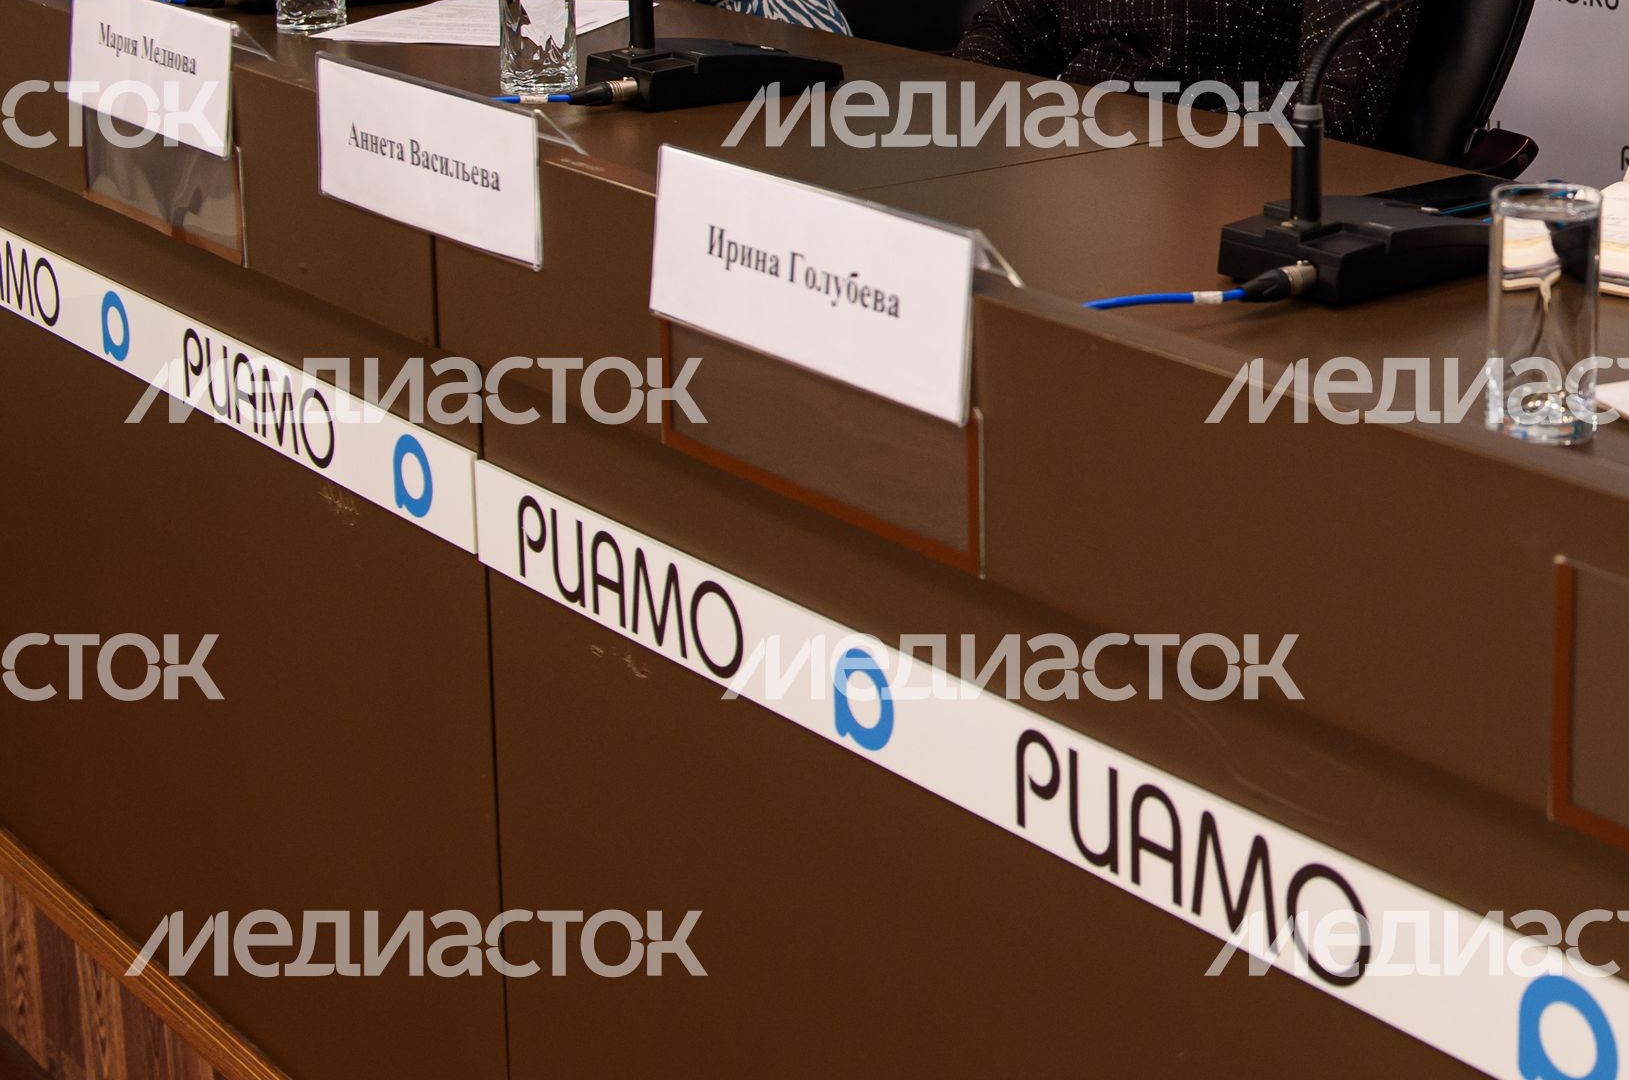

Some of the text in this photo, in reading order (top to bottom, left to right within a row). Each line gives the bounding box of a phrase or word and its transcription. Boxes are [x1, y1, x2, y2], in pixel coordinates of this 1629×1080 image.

[98, 21, 139, 58] Мария
[347, 121, 502, 192] Аннета Васильева
[706, 224, 901, 319] Ирина Голубева
